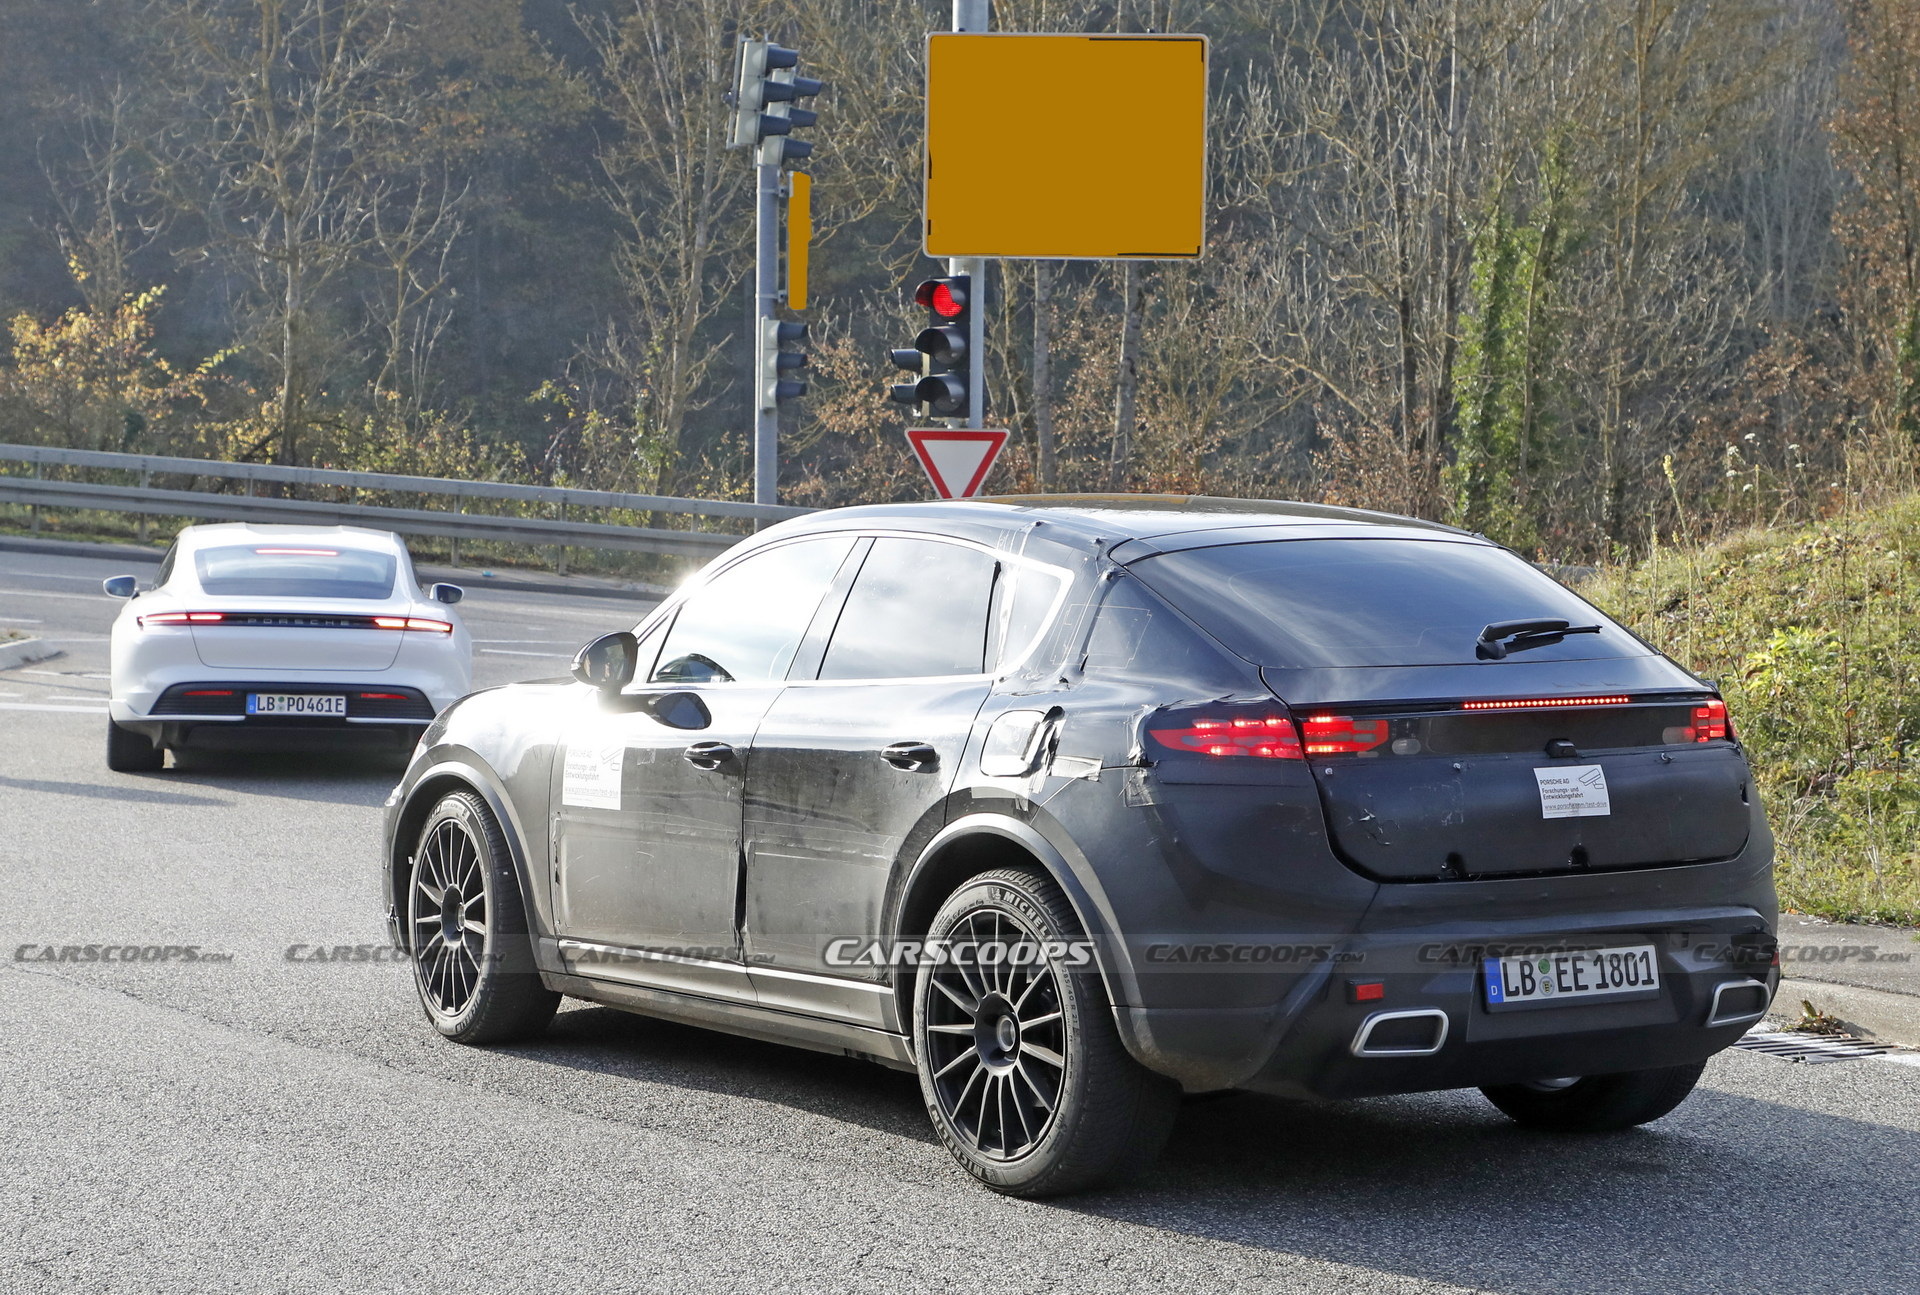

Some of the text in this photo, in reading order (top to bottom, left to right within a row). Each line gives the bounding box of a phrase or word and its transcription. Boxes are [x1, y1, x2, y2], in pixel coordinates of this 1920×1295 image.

[247, 617, 350, 626] PORSCHE
[257, 696, 275, 711] LB
[1003, 890, 1062, 955] MICHELI
[1502, 950, 1656, 997] LB EE 1801
[1491, 985, 1498, 996] D
